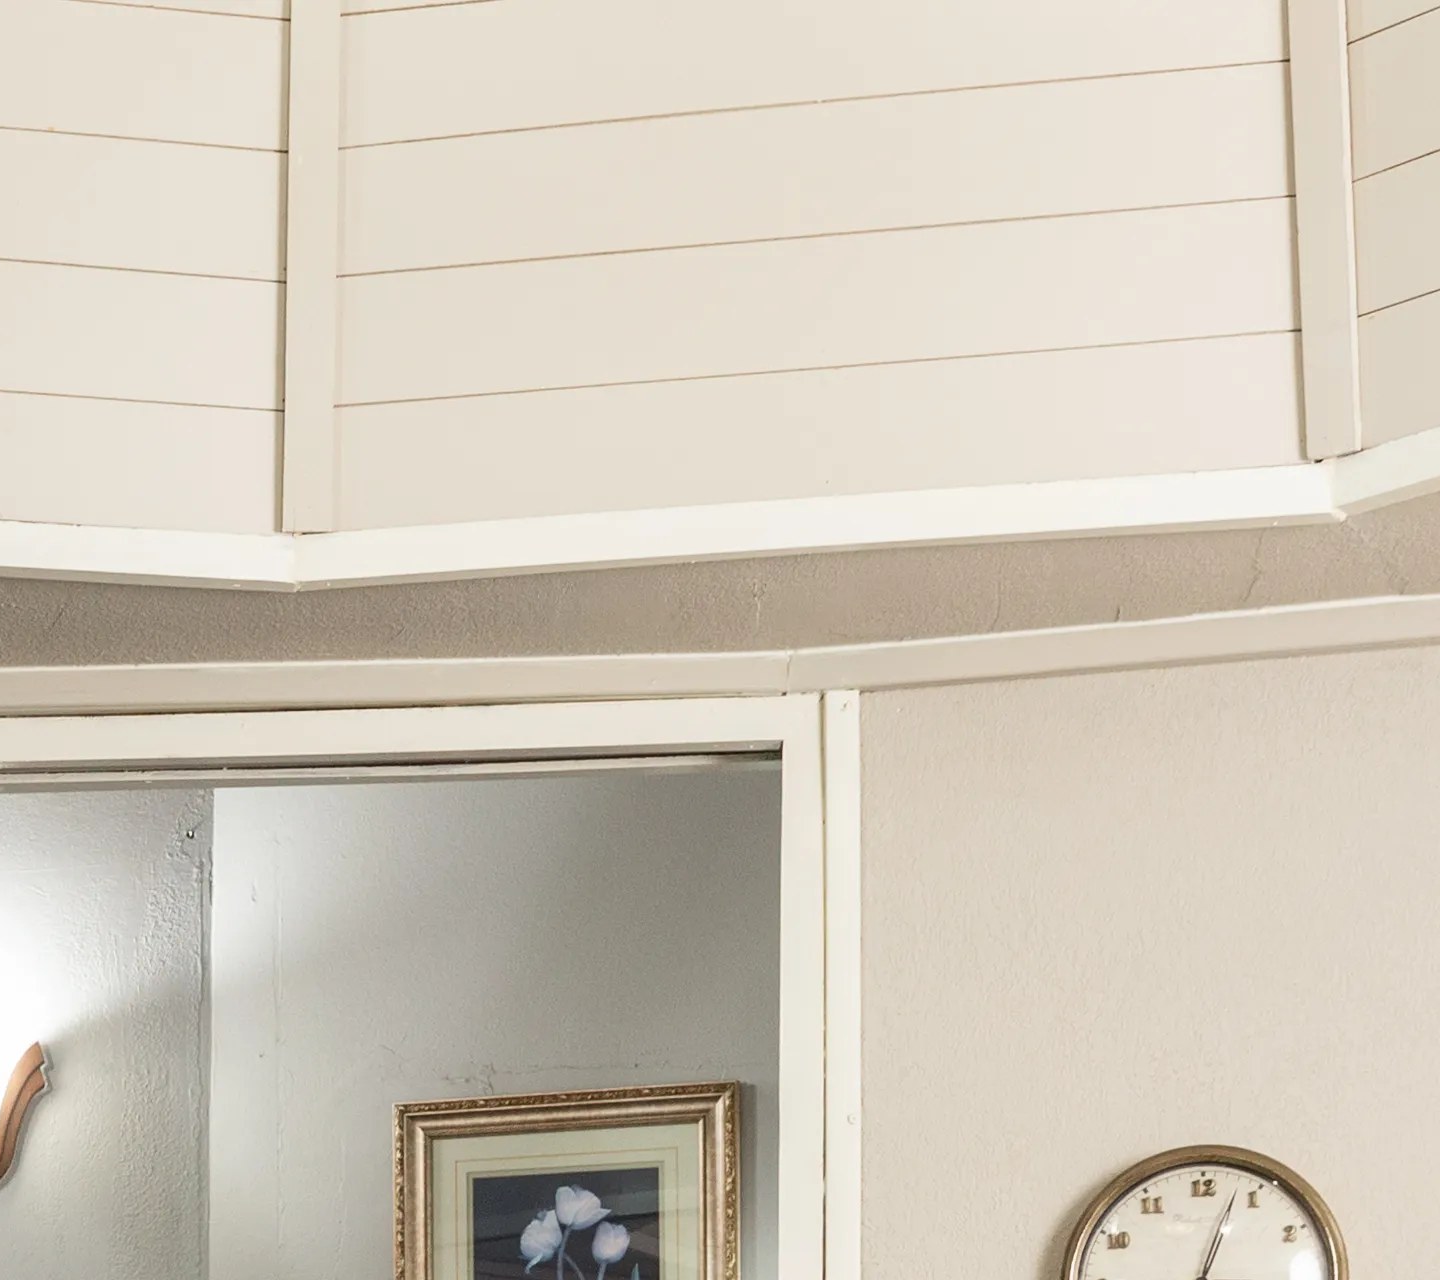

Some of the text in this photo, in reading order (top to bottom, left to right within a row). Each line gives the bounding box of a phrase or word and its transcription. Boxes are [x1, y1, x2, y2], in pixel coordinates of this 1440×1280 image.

[1191, 1178, 1217, 1198] 12
[1140, 1196, 1165, 1214] 11
[1247, 1190, 1260, 1209] 1
[1107, 1230, 1131, 1250] 10
[1282, 1225, 1298, 1243] 2
